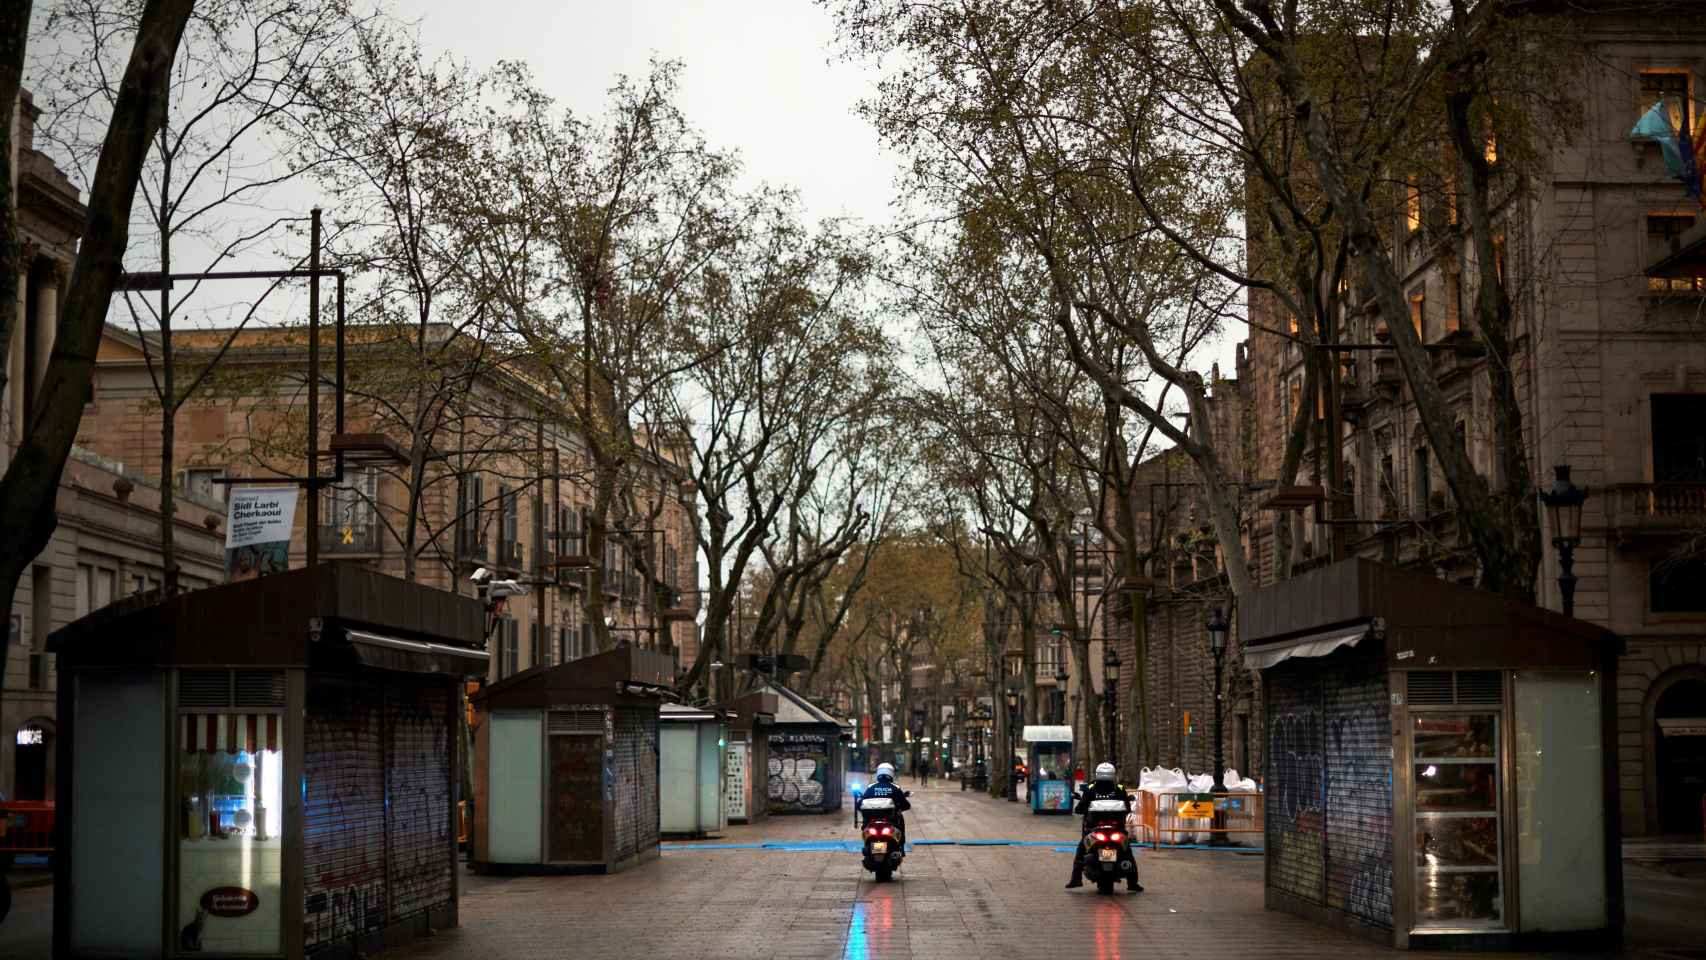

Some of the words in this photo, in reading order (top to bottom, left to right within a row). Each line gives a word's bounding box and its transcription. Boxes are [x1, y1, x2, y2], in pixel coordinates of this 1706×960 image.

[234, 502, 252, 511] Sidi
[254, 500, 279, 509] Larbi
[233, 509, 282, 520] Cherkaoui
